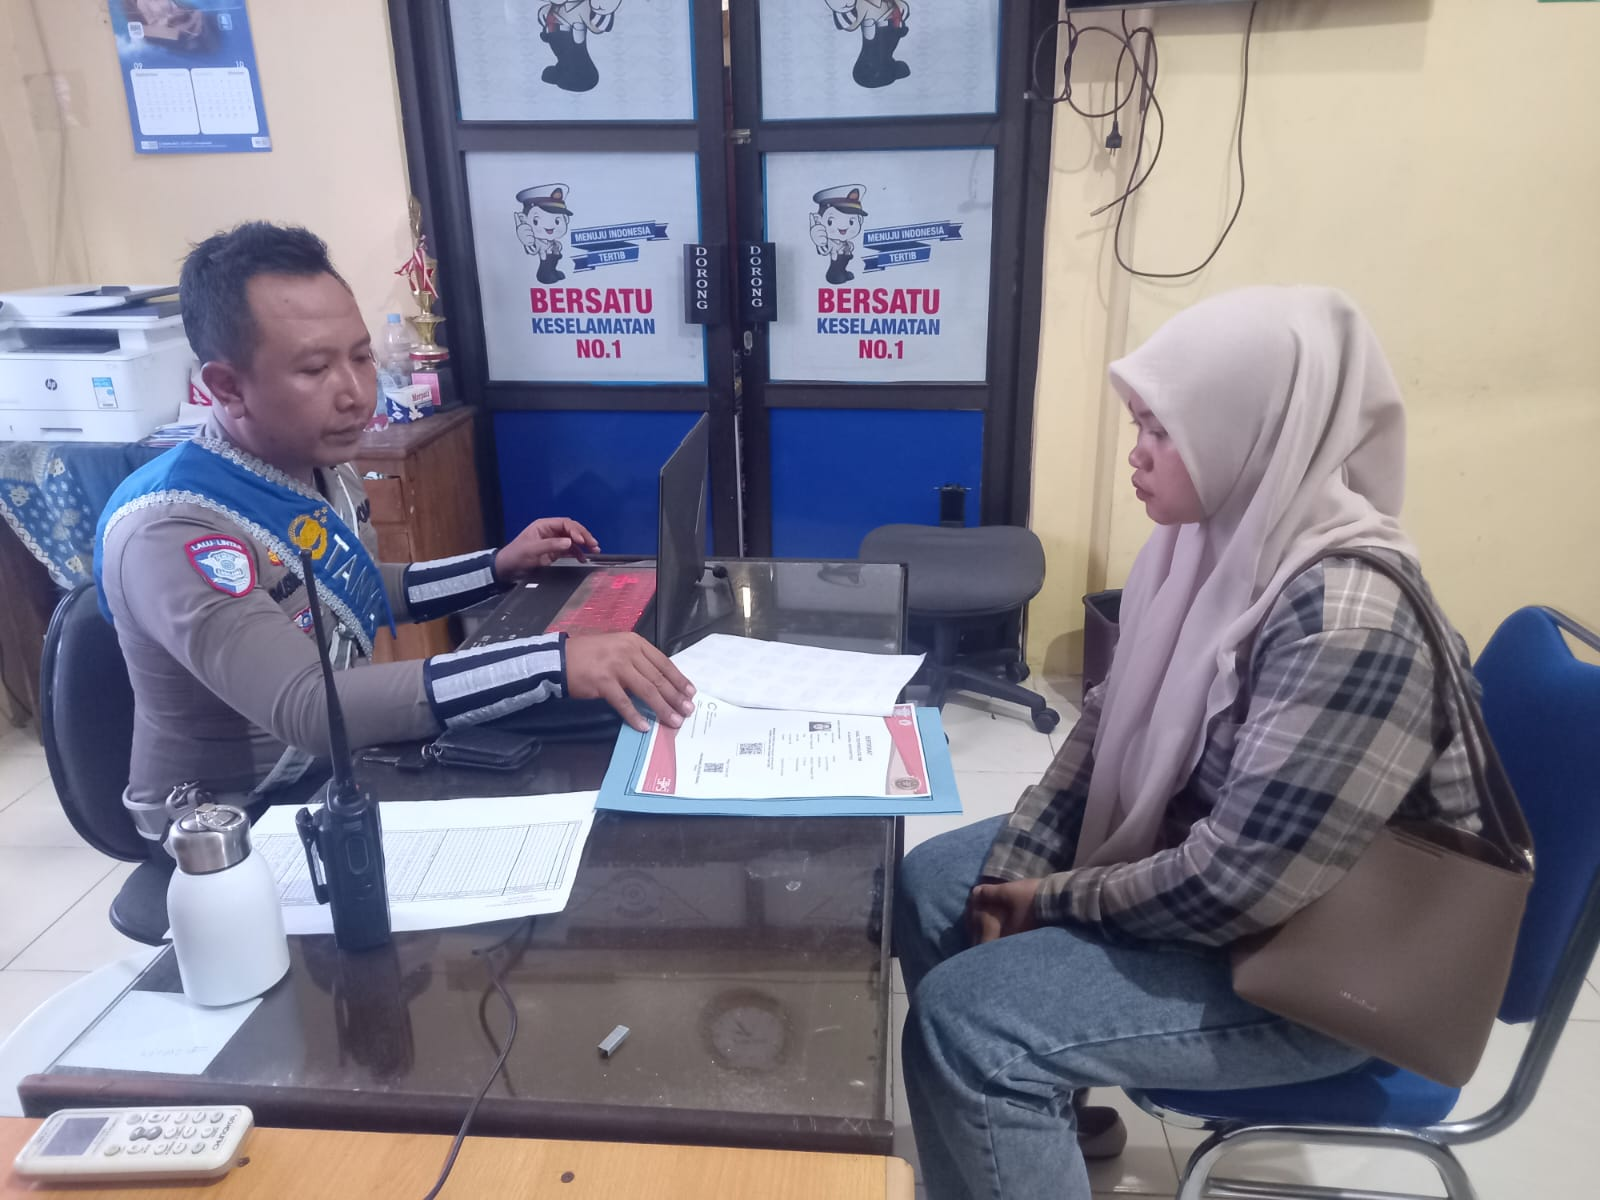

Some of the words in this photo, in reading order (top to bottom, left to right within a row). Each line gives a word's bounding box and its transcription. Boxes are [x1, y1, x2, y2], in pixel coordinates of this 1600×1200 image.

[574, 227, 607, 242] MENUJU
[609, 225, 651, 239] INDONESIA
[867, 228, 900, 242] MENUJU
[902, 226, 945, 239] INDONESIA
[598, 251, 626, 262] TERTIB
[889, 251, 917, 263] TERTIB
[695, 247, 708, 310] DORONG
[750, 246, 763, 308] DORONG
[530, 288, 653, 314] BERSATU
[818, 288, 940, 314] BERSATU
[532, 317, 655, 335] KESELAMATAN
[817, 317, 940, 335] KESELAMATAN
[576, 339, 622, 359] NO.1
[859, 340, 904, 359] NO.1
